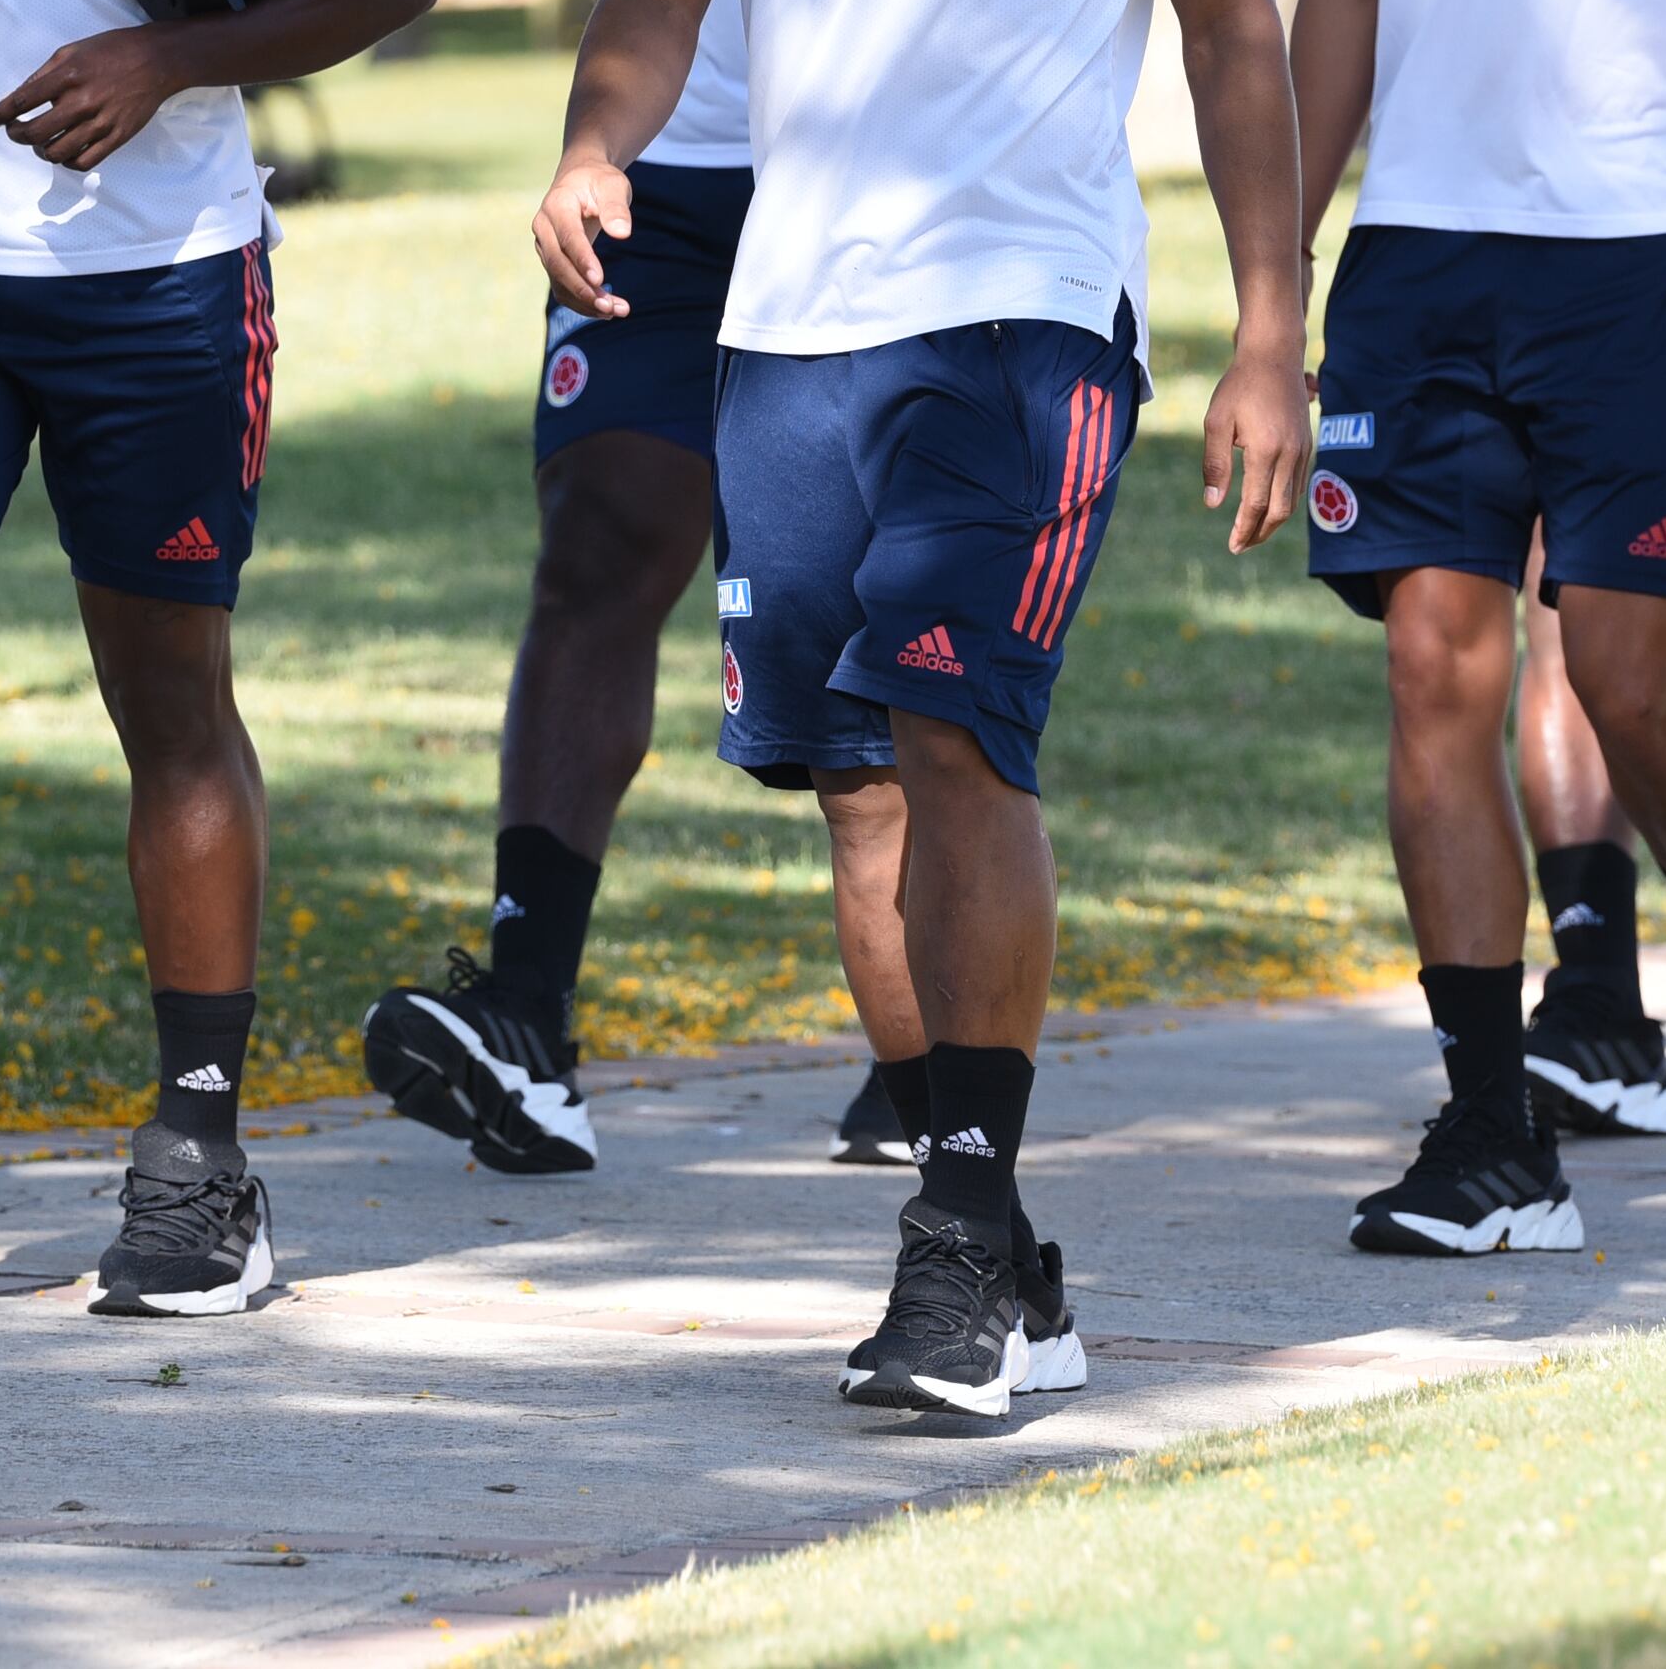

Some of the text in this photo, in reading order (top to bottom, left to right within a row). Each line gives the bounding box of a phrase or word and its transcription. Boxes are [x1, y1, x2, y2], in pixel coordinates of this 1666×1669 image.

[1320, 416, 1370, 444] GUILA
[156, 545, 221, 561] adidas
[897, 650, 965, 677] adidas
[176, 1077, 231, 1092] adidas
[940, 1139, 997, 1159] adidas
